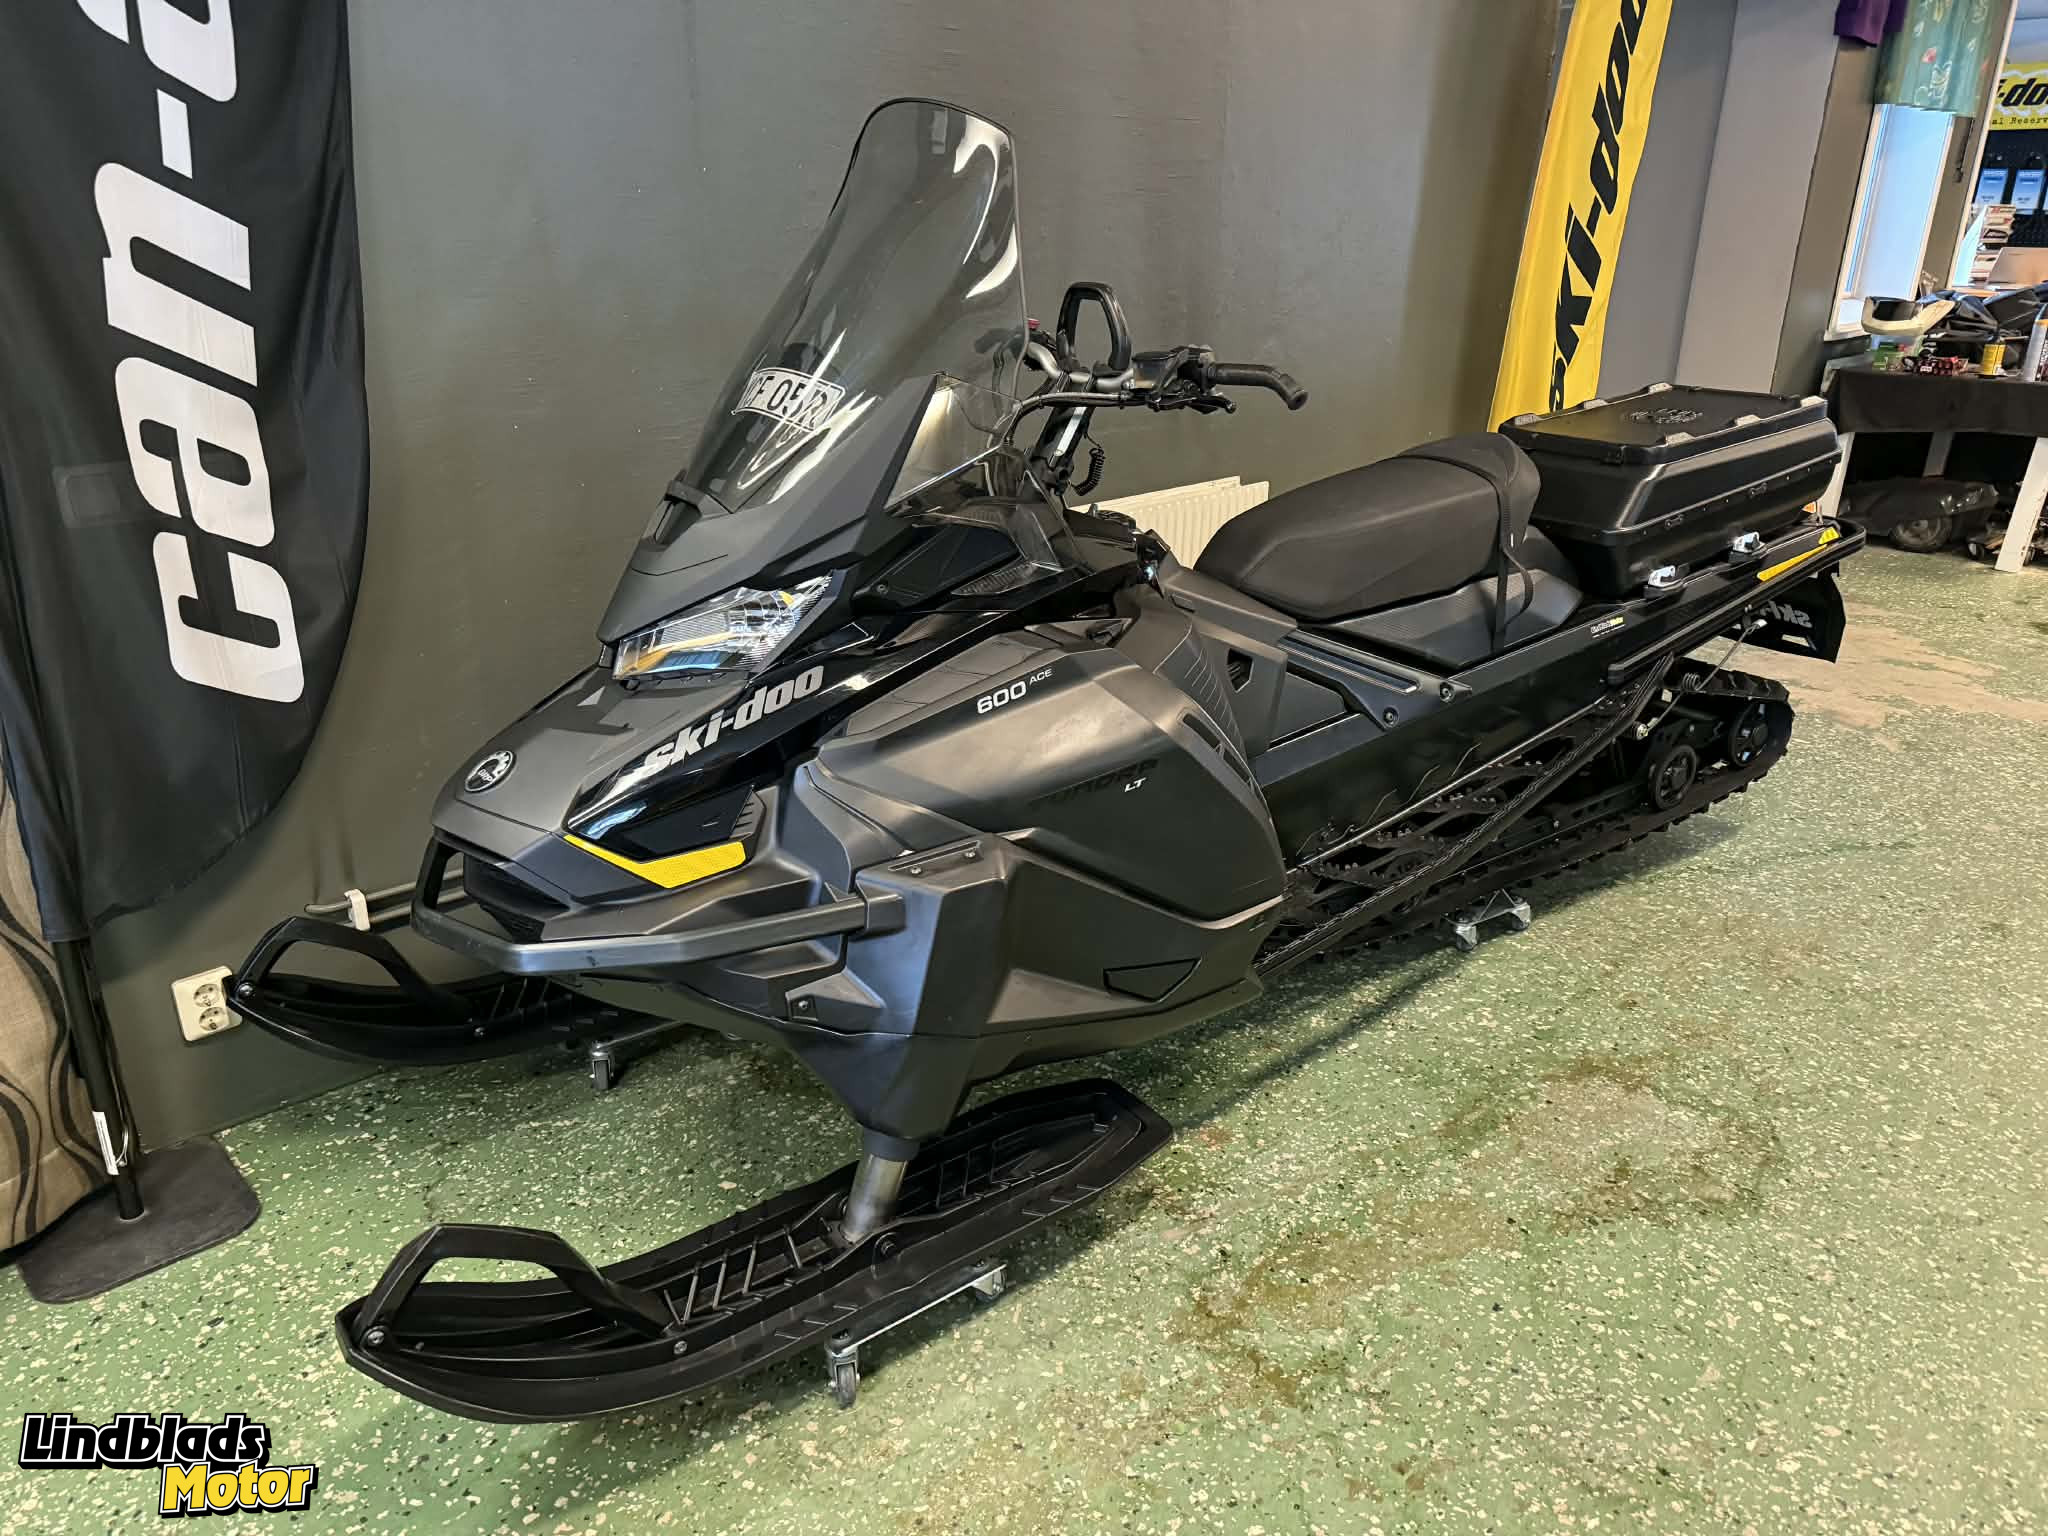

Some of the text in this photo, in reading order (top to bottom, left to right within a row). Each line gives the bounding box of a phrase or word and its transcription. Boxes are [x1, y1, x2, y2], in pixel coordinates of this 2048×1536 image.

[976, 668, 1054, 715] 600 ACE
[1124, 777, 1147, 793] LT
